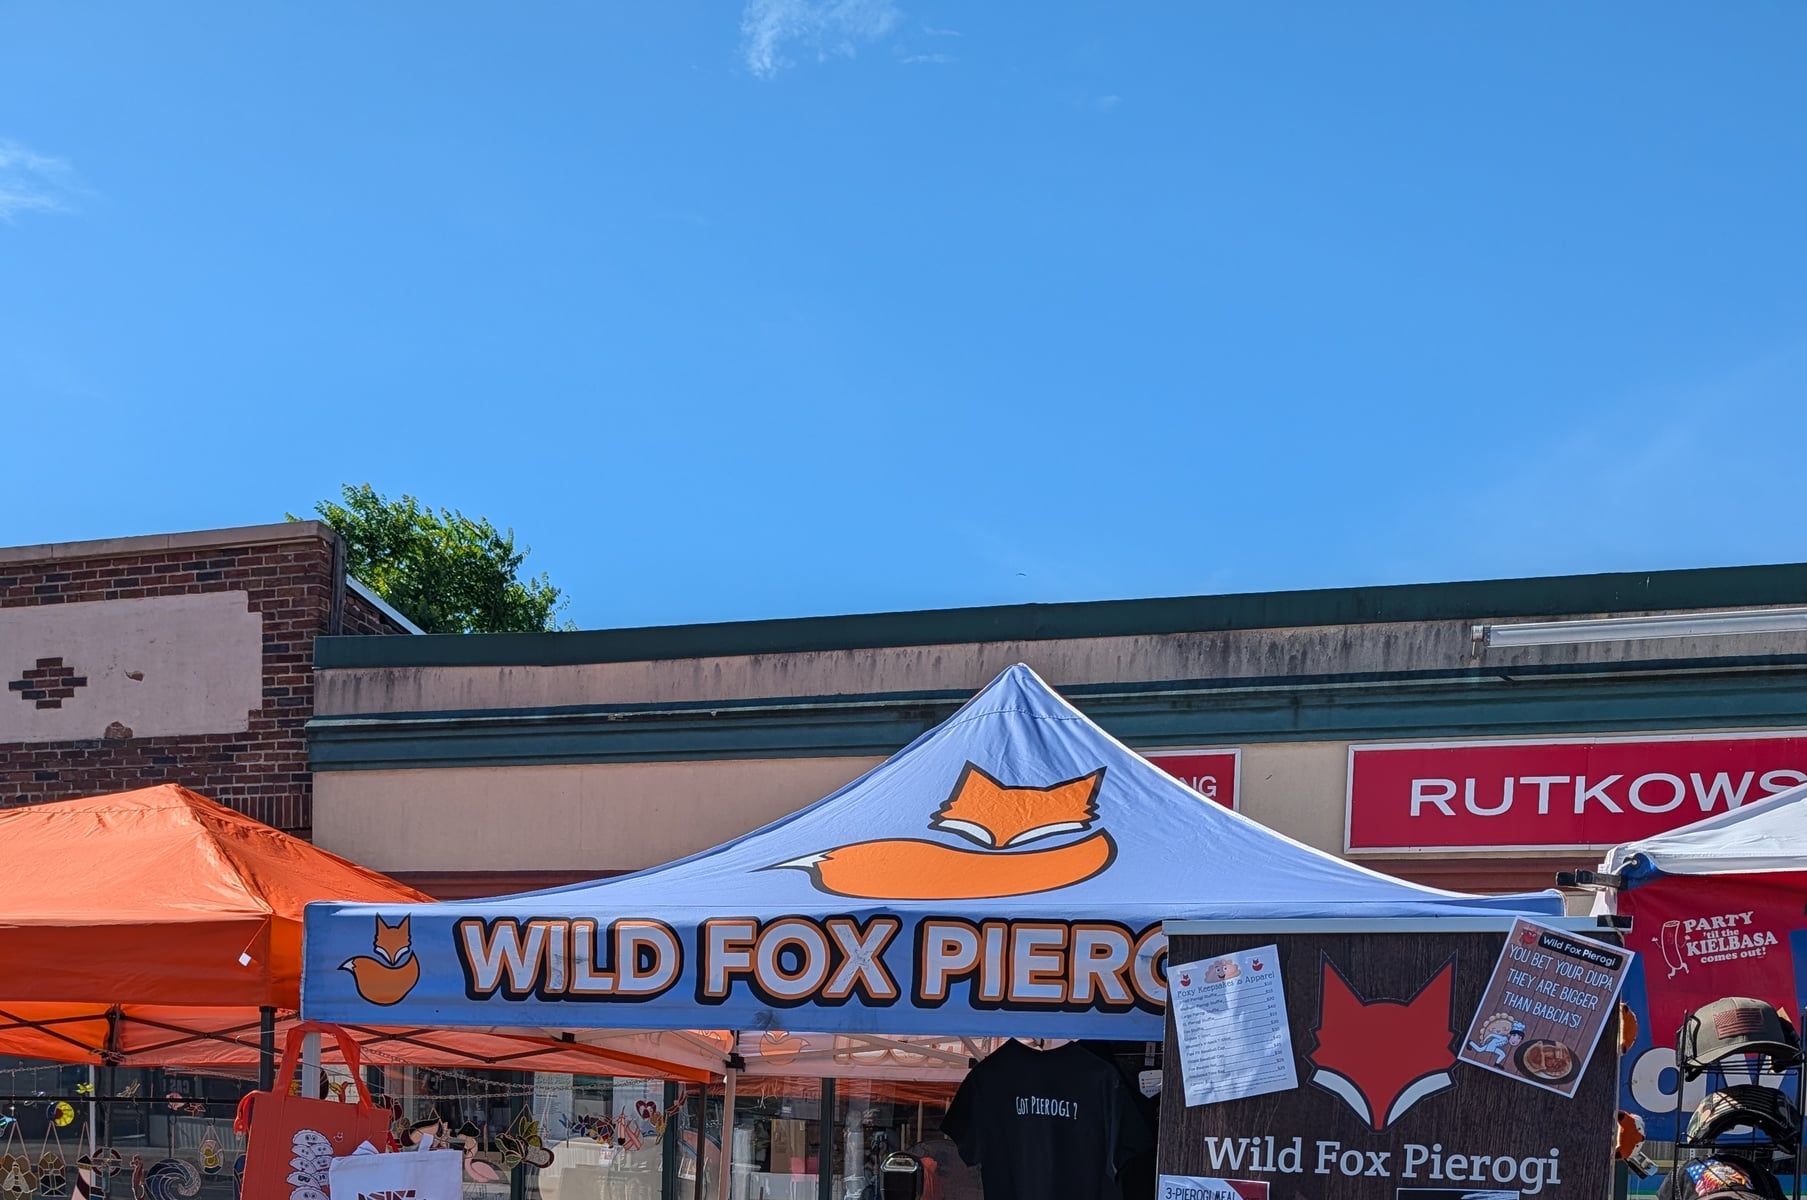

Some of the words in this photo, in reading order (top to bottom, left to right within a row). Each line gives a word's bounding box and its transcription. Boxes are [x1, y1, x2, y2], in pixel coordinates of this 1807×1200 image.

[1683, 911, 1754, 933] PARTY
[1722, 929, 1739, 937] the
[1543, 936, 1563, 949] Wild
[1565, 943, 1581, 956] Fox
[1582, 948, 1616, 966] Pierogi
[1686, 931, 1779, 957] KIELBASA
[1700, 953, 1738, 964] comes
[1740, 947, 1767, 958] out!
[459, 919, 680, 998] WILD
[702, 917, 898, 1000] FOX
[1509, 944, 1529, 963] YOU
[1531, 952, 1553, 970] BET
[1556, 959, 1583, 982] YOUR
[1177, 988, 1196, 998] Foxy
[1198, 980, 1234, 993] Keepsakes
[1245, 972, 1275, 985] Apparel
[1507, 968, 1536, 989] THEY
[1536, 980, 1560, 998] ARE
[1560, 986, 1599, 1011] BIGGER
[1503, 991, 1532, 1012] THAN
[1532, 1002, 1582, 1029] BABCIA'S!
[1031, 1096, 1070, 1118] PIEROGI
[1204, 1136, 1303, 1173] Wild
[1315, 1140, 1390, 1177] Fox
[1402, 1144, 1561, 1195] Pierogi
